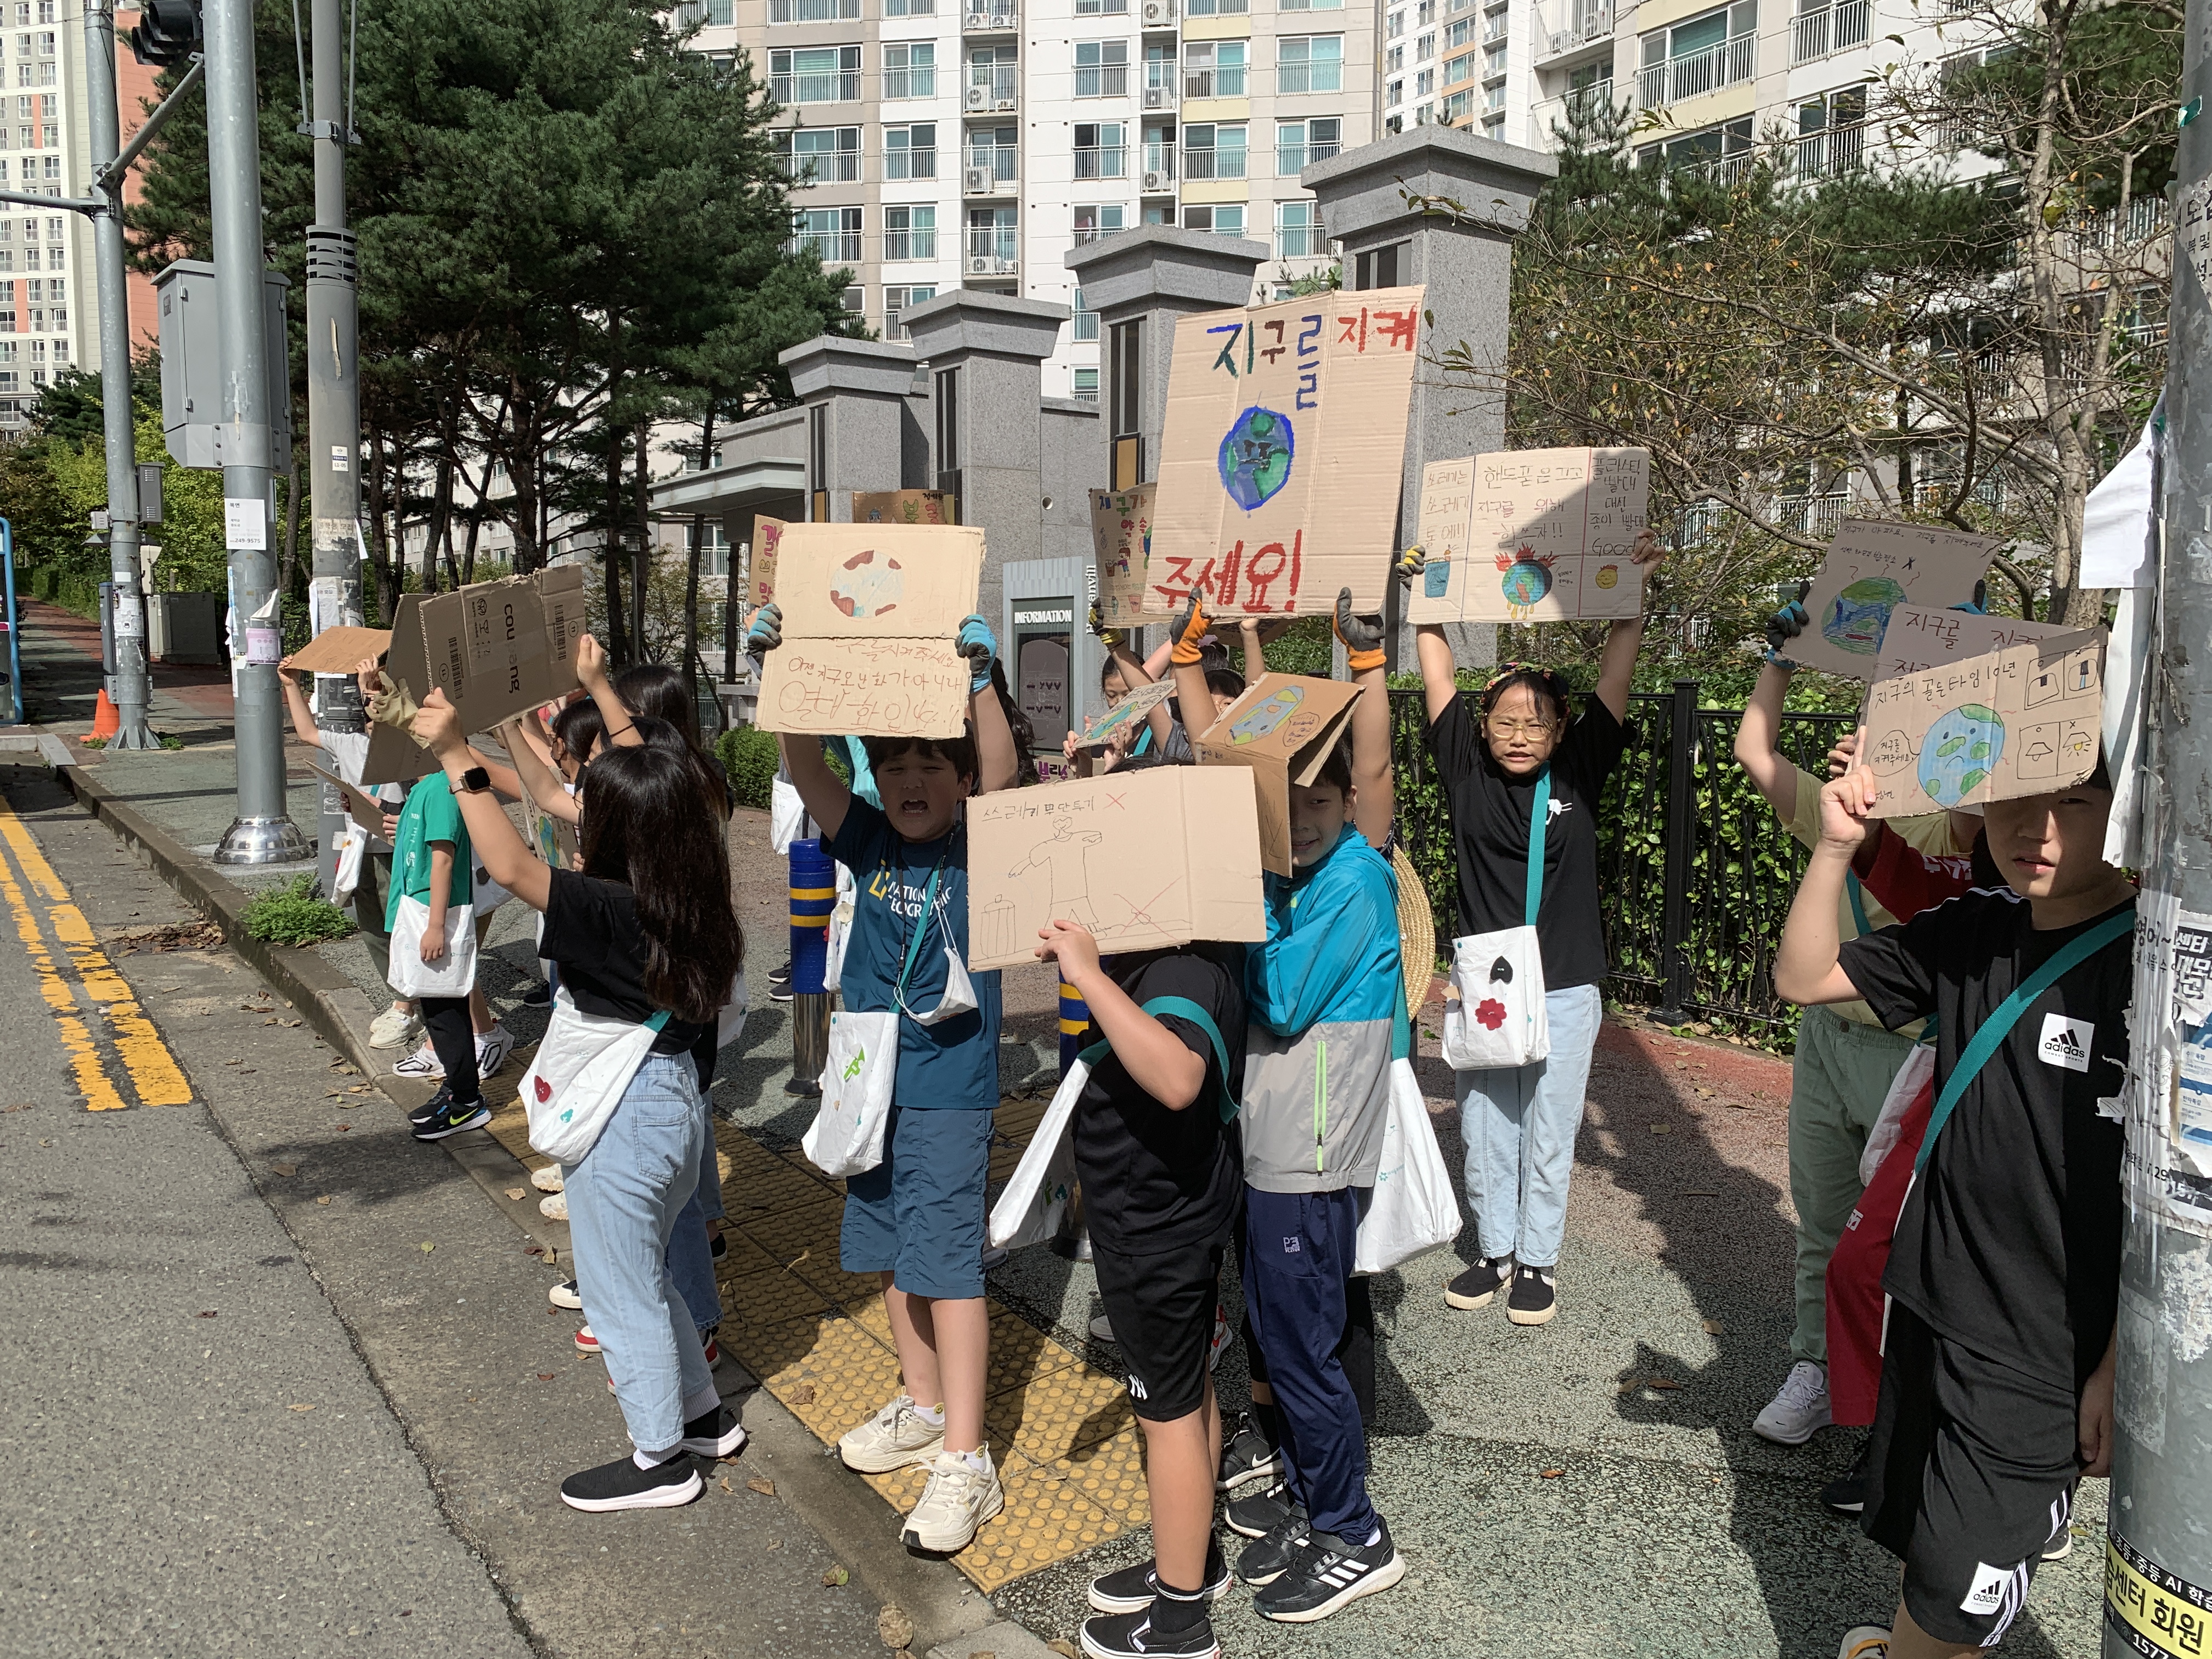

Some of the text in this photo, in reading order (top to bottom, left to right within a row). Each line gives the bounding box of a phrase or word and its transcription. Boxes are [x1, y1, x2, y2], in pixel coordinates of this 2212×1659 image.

[1206, 314, 1322, 411] 지구를
[1591, 458, 1641, 481] 플라스틱
[1604, 475, 1637, 493] 빨대
[1477, 498, 1564, 517] 지구를 위해
[1605, 496, 1626, 512] 대신
[1590, 513, 1612, 529] 종이
[1153, 528, 1302, 613] 주세요!
[1086, 565, 1096, 634] Hanvill
[1014, 610, 1072, 624] INFORMATION
[1905, 612, 1960, 650] 지구를
[1875, 681, 1915, 709] 지구의
[1881, 738, 1900, 753] 지구를
[981, 801, 1039, 822] 쓰레기
[888, 881, 927, 902] NATION
[2045, 1042, 2085, 1058] adidas
[2165, 1576, 2182, 1593] AI
[1973, 1593, 2000, 1604] adidas
[2151, 1597, 2204, 1656] 회원
